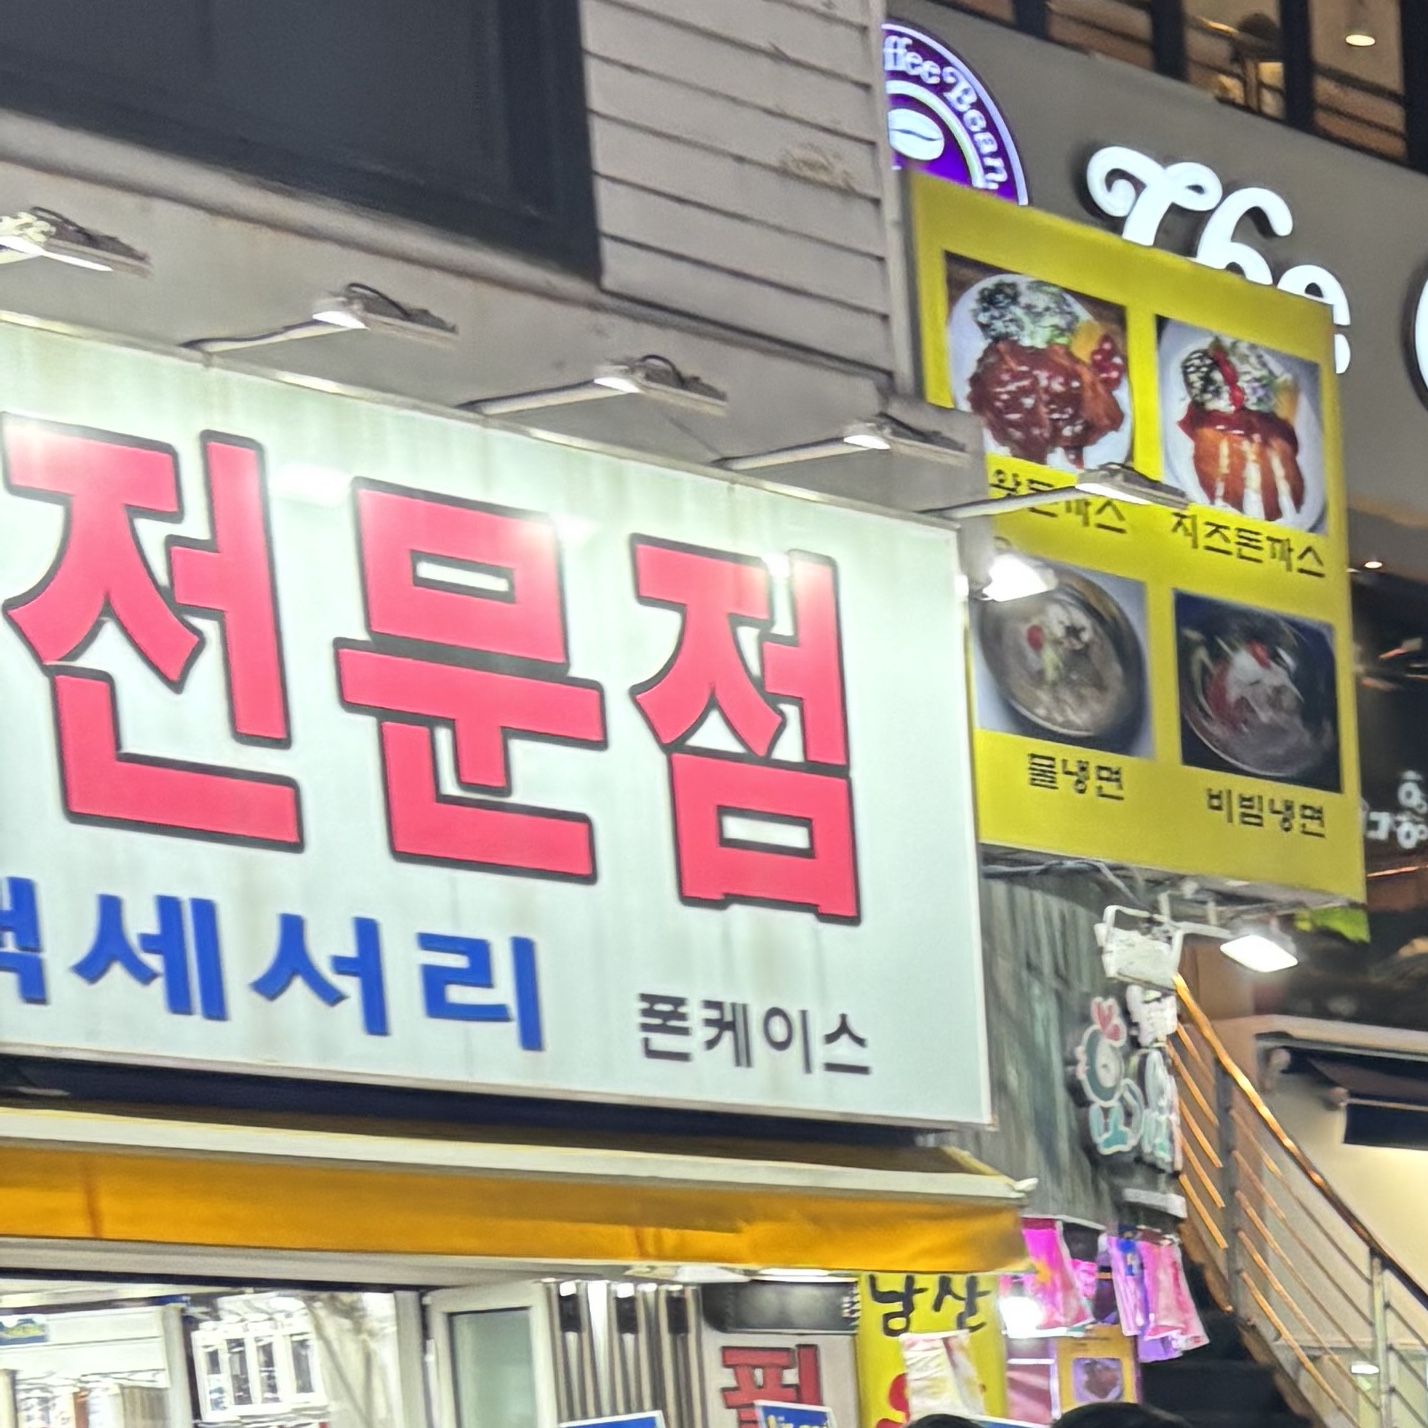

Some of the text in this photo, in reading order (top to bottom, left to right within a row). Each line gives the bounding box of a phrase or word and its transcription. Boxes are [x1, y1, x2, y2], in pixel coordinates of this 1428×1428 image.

[942, 66, 1008, 190] Bean
[1171, 511, 1326, 578] 치즈돈까스
[2, 411, 862, 924] 전문점
[1027, 752, 1125, 801] 물냉면
[1206, 787, 1326, 838] 비빔냉면
[637, 992, 873, 1076] 폰케이스
